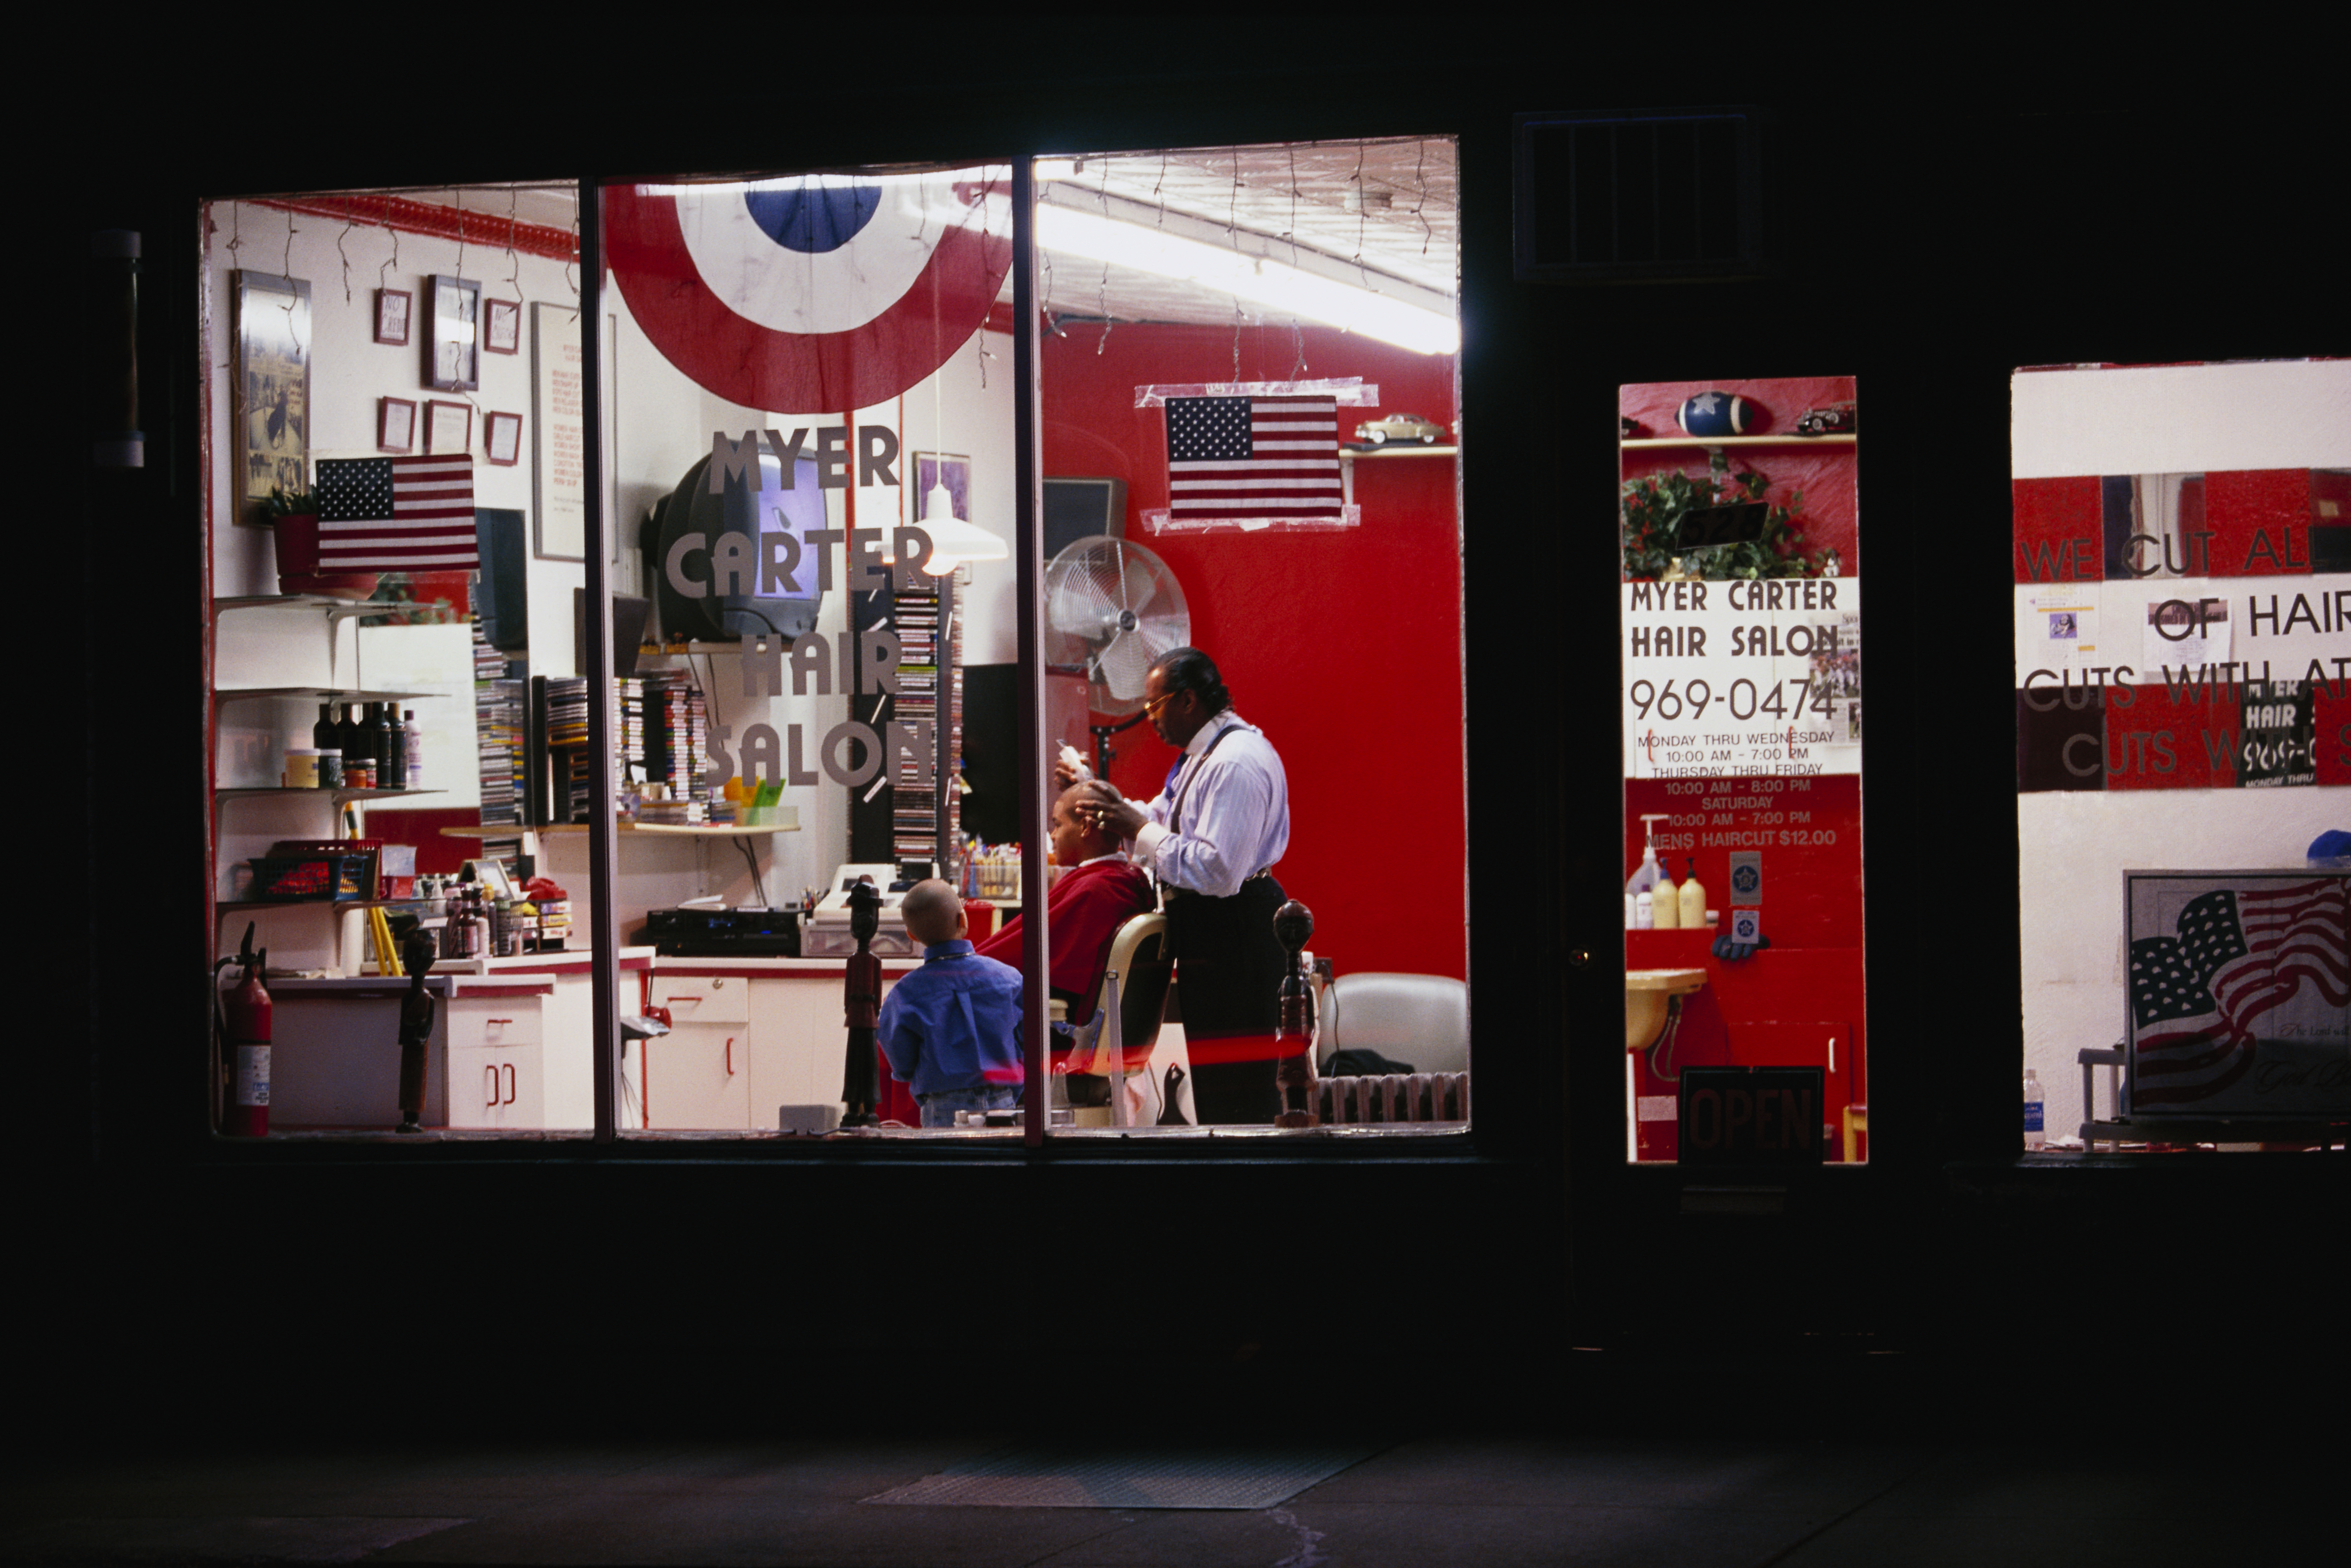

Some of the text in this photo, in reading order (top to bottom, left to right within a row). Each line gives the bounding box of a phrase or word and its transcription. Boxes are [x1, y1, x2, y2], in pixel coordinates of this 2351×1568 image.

[709, 425, 900, 495] MYER
[1682, 504, 1765, 546] 528
[666, 526, 938, 599] CARTER
[2021, 538, 2093, 581] WE
[2121, 531, 2215, 577] CUT
[1631, 580, 1837, 611] MYER CARTER
[2154, 598, 2220, 641] OF
[1631, 625, 1838, 657] HAIR SALON
[741, 630, 904, 696] HAIR
[1630, 678, 1837, 720] 969-0474
[2022, 665, 2138, 712] CUTS
[2161, 660, 2271, 705] WITH
[2248, 680, 2299, 699] MER
[2246, 704, 2297, 729] HAIR
[704, 721, 933, 788] SALON
[1638, 731, 1835, 748] MONDAY THRU WEDNESDAY
[1666, 751, 1704, 763] 10:00
[1710, 750, 1732, 761] AM
[1751, 748, 1782, 761] 7:00
[1789, 747, 1809, 759] PM
[2062, 731, 2177, 777] CUTS
[2202, 726, 2311, 770] WITH
[1652, 763, 1823, 779] THURSDAY THRU FRIDAY
[1665, 782, 1704, 795] 10:00
[1710, 781, 1732, 794] AM
[1751, 780, 1784, 793] 8:00
[1790, 779, 1811, 791] PM
[1668, 814, 1706, 827] 10:00
[1712, 813, 1733, 825] AM
[1752, 812, 1783, 824] 7:00
[1789, 811, 1811, 824] PM
[1702, 796, 1774, 811] SATURDAY
[1645, 829, 1836, 848] MENS HAIRCUT $12.00
[1689, 1088, 1811, 1150] OPEN
